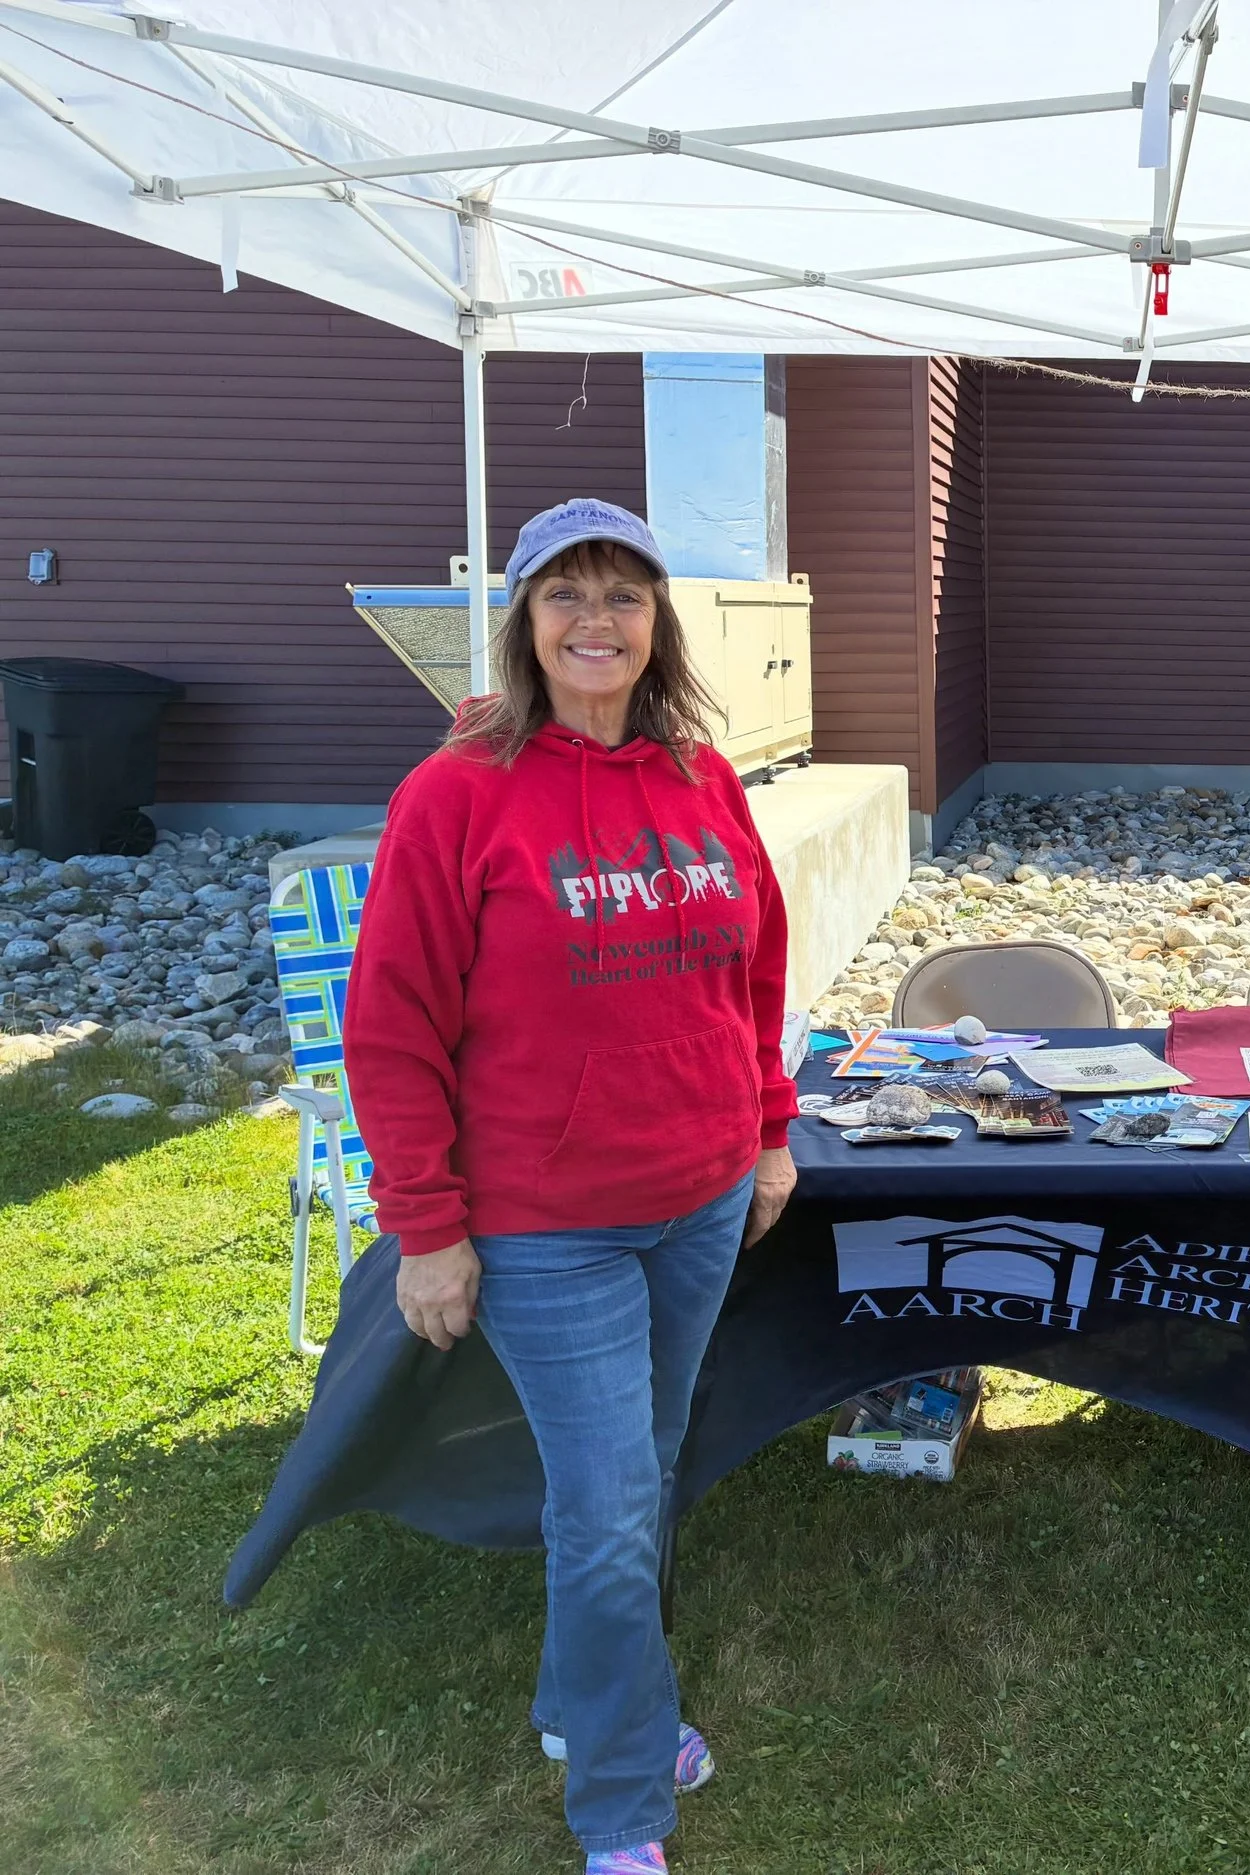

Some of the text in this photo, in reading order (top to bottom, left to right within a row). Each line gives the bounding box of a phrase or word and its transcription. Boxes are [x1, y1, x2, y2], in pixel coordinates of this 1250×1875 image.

[570, 968, 632, 985] Heart
[637, 965, 658, 979] of
[702, 949, 743, 969] Park
[840, 1291, 1083, 1332] AARCH
[866, 1460, 909, 1469] STRAWBERRY
[871, 1452, 905, 1460] ORGANIC
